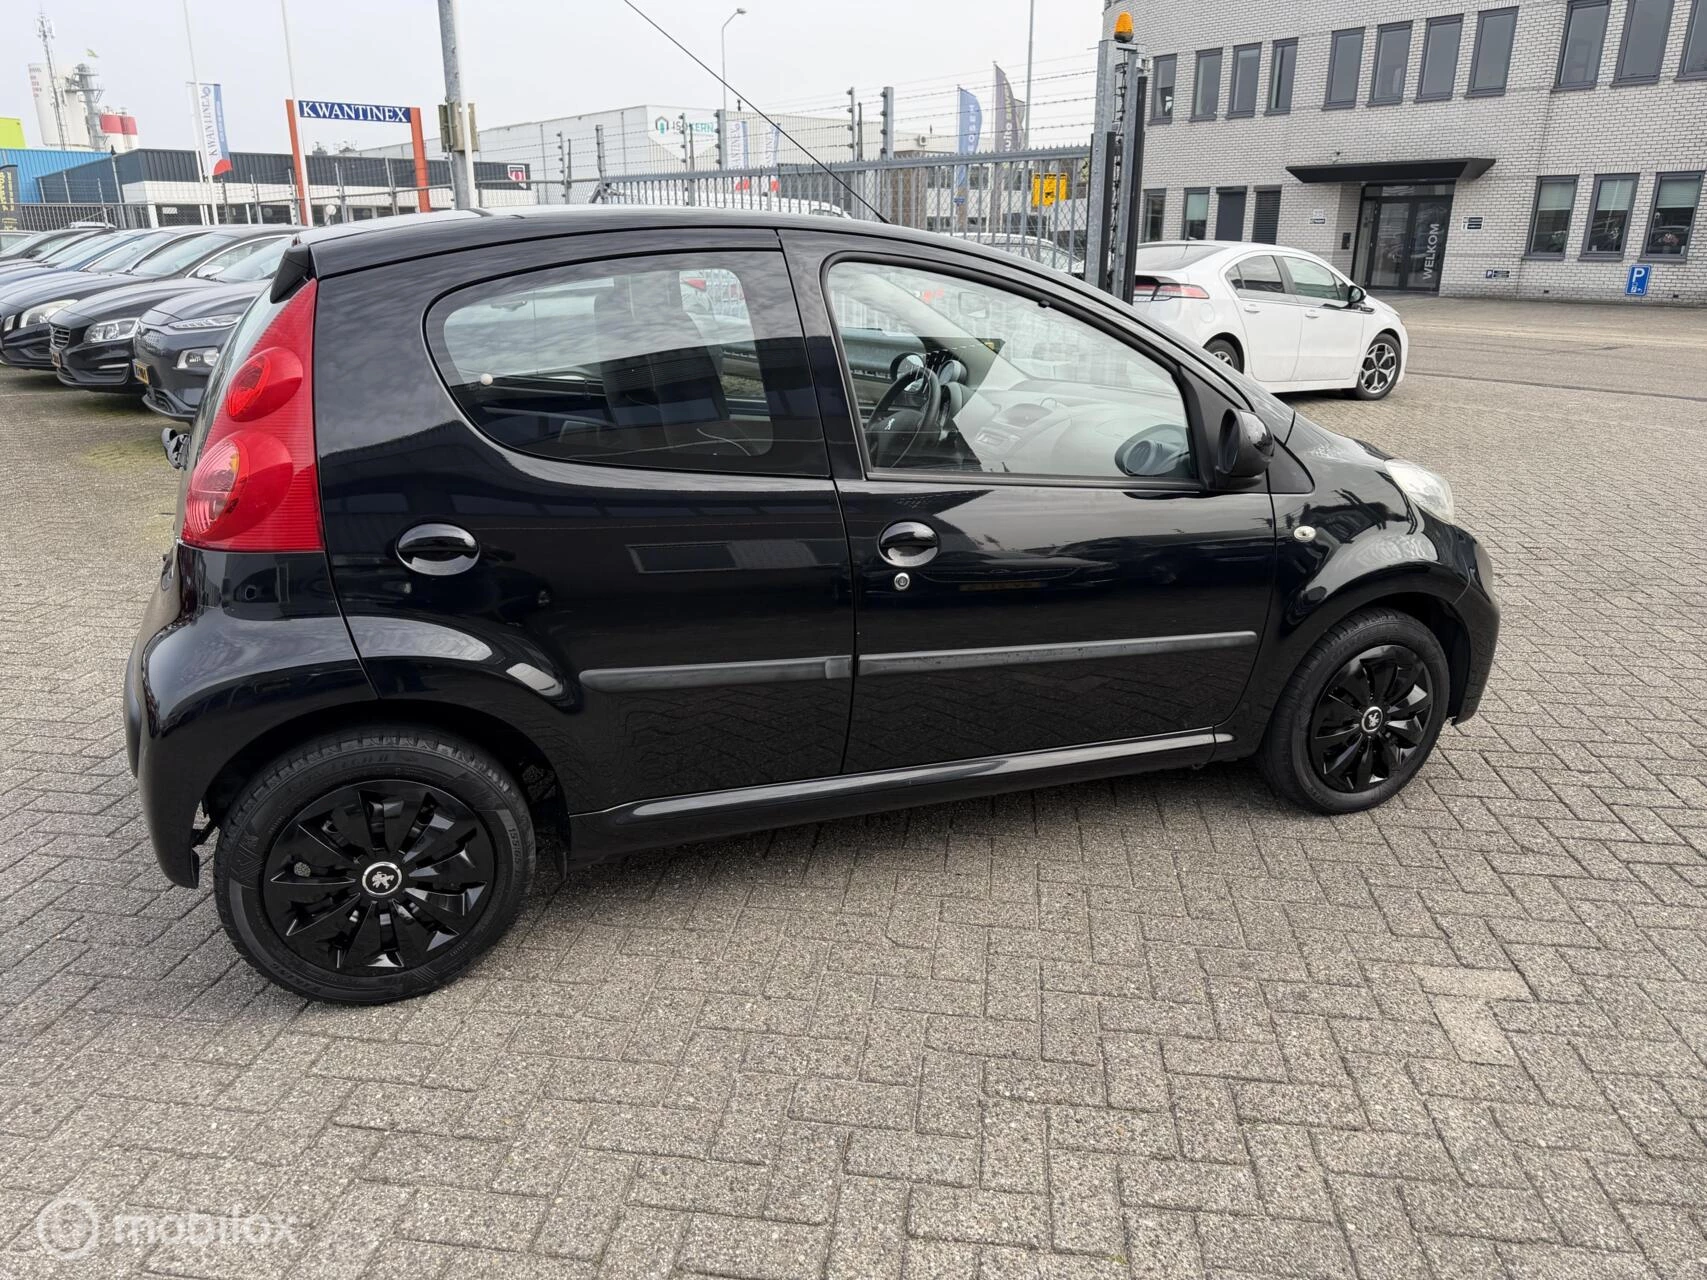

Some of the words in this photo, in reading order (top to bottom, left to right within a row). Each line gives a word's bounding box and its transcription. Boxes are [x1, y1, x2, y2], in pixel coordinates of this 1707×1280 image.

[302, 101, 408, 122] KWANTINEX
[1422, 223, 1440, 280] WELKOM
[1632, 268, 1645, 283] P
